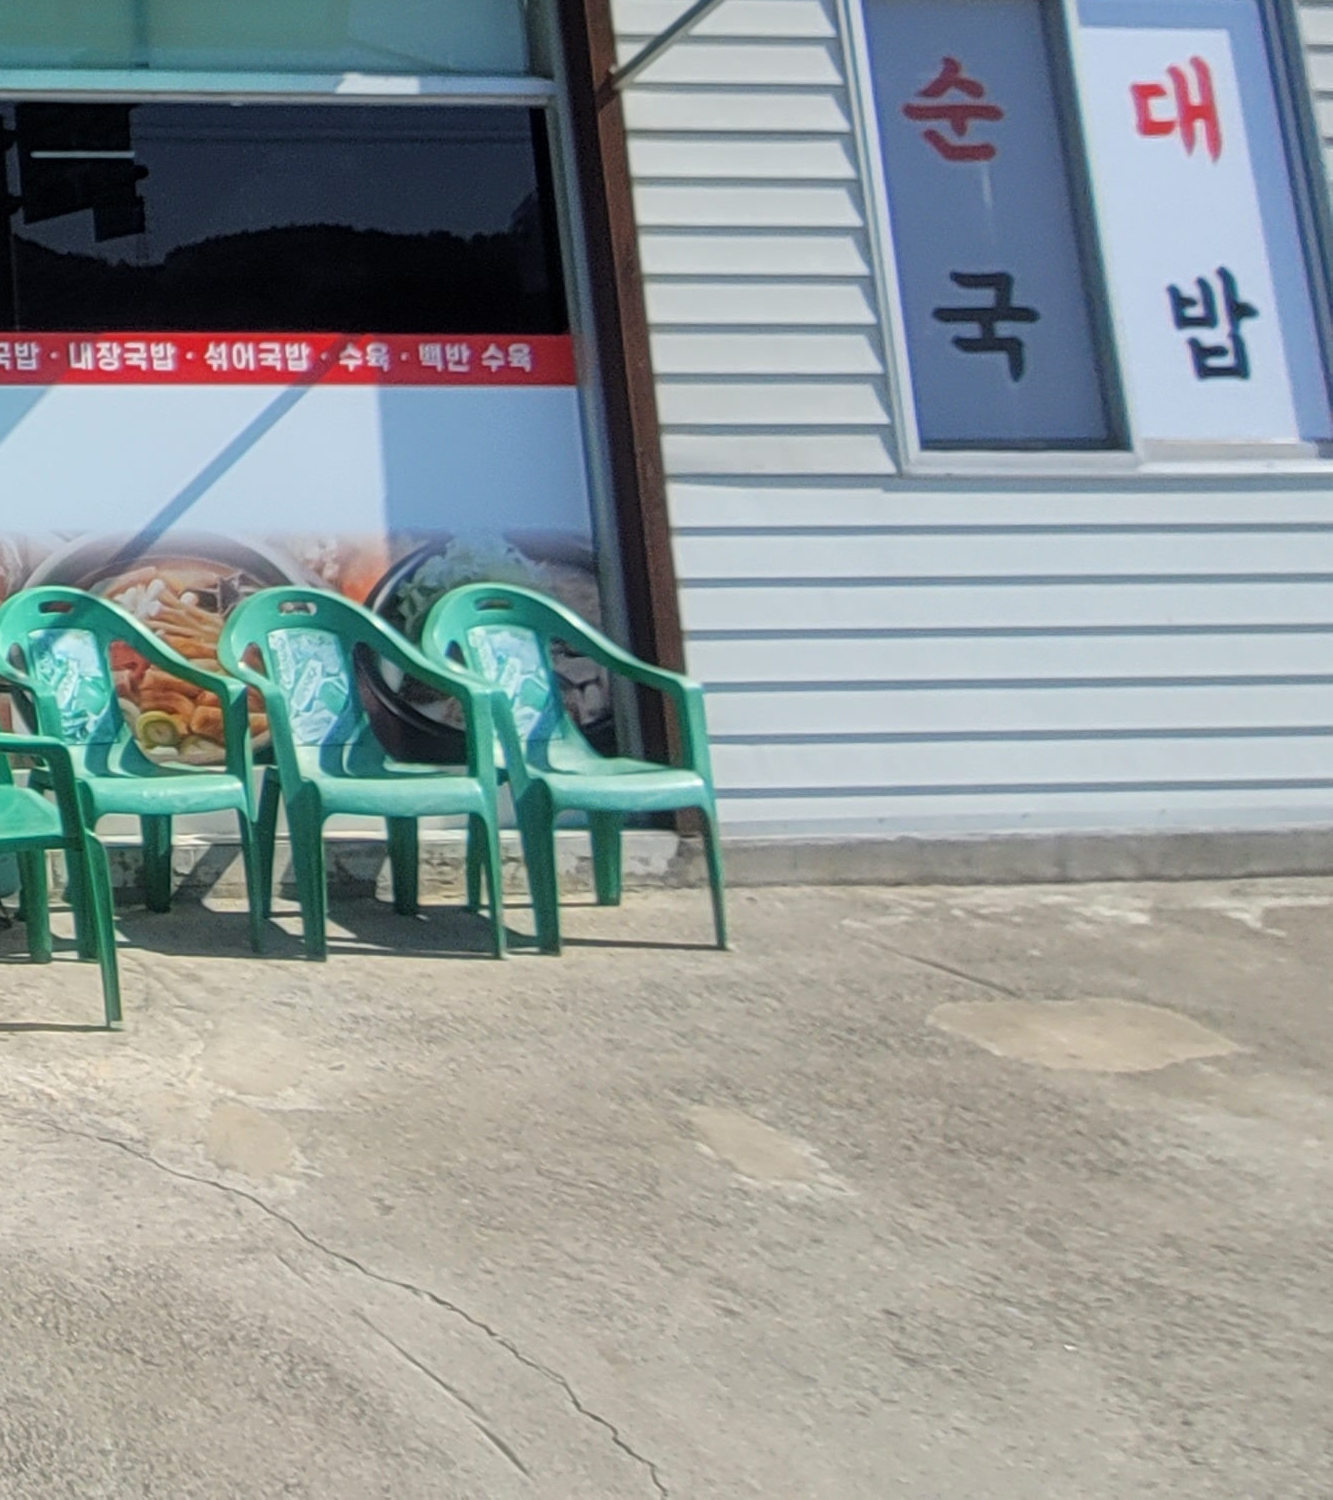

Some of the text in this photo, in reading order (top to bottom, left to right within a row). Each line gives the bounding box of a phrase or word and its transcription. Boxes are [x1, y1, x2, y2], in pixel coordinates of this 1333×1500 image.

[68, 341, 177, 371] 내장국밥
[204, 341, 312, 372] 섞어국밥
[338, 342, 389, 372] 수육
[418, 342, 470, 372] 백반
